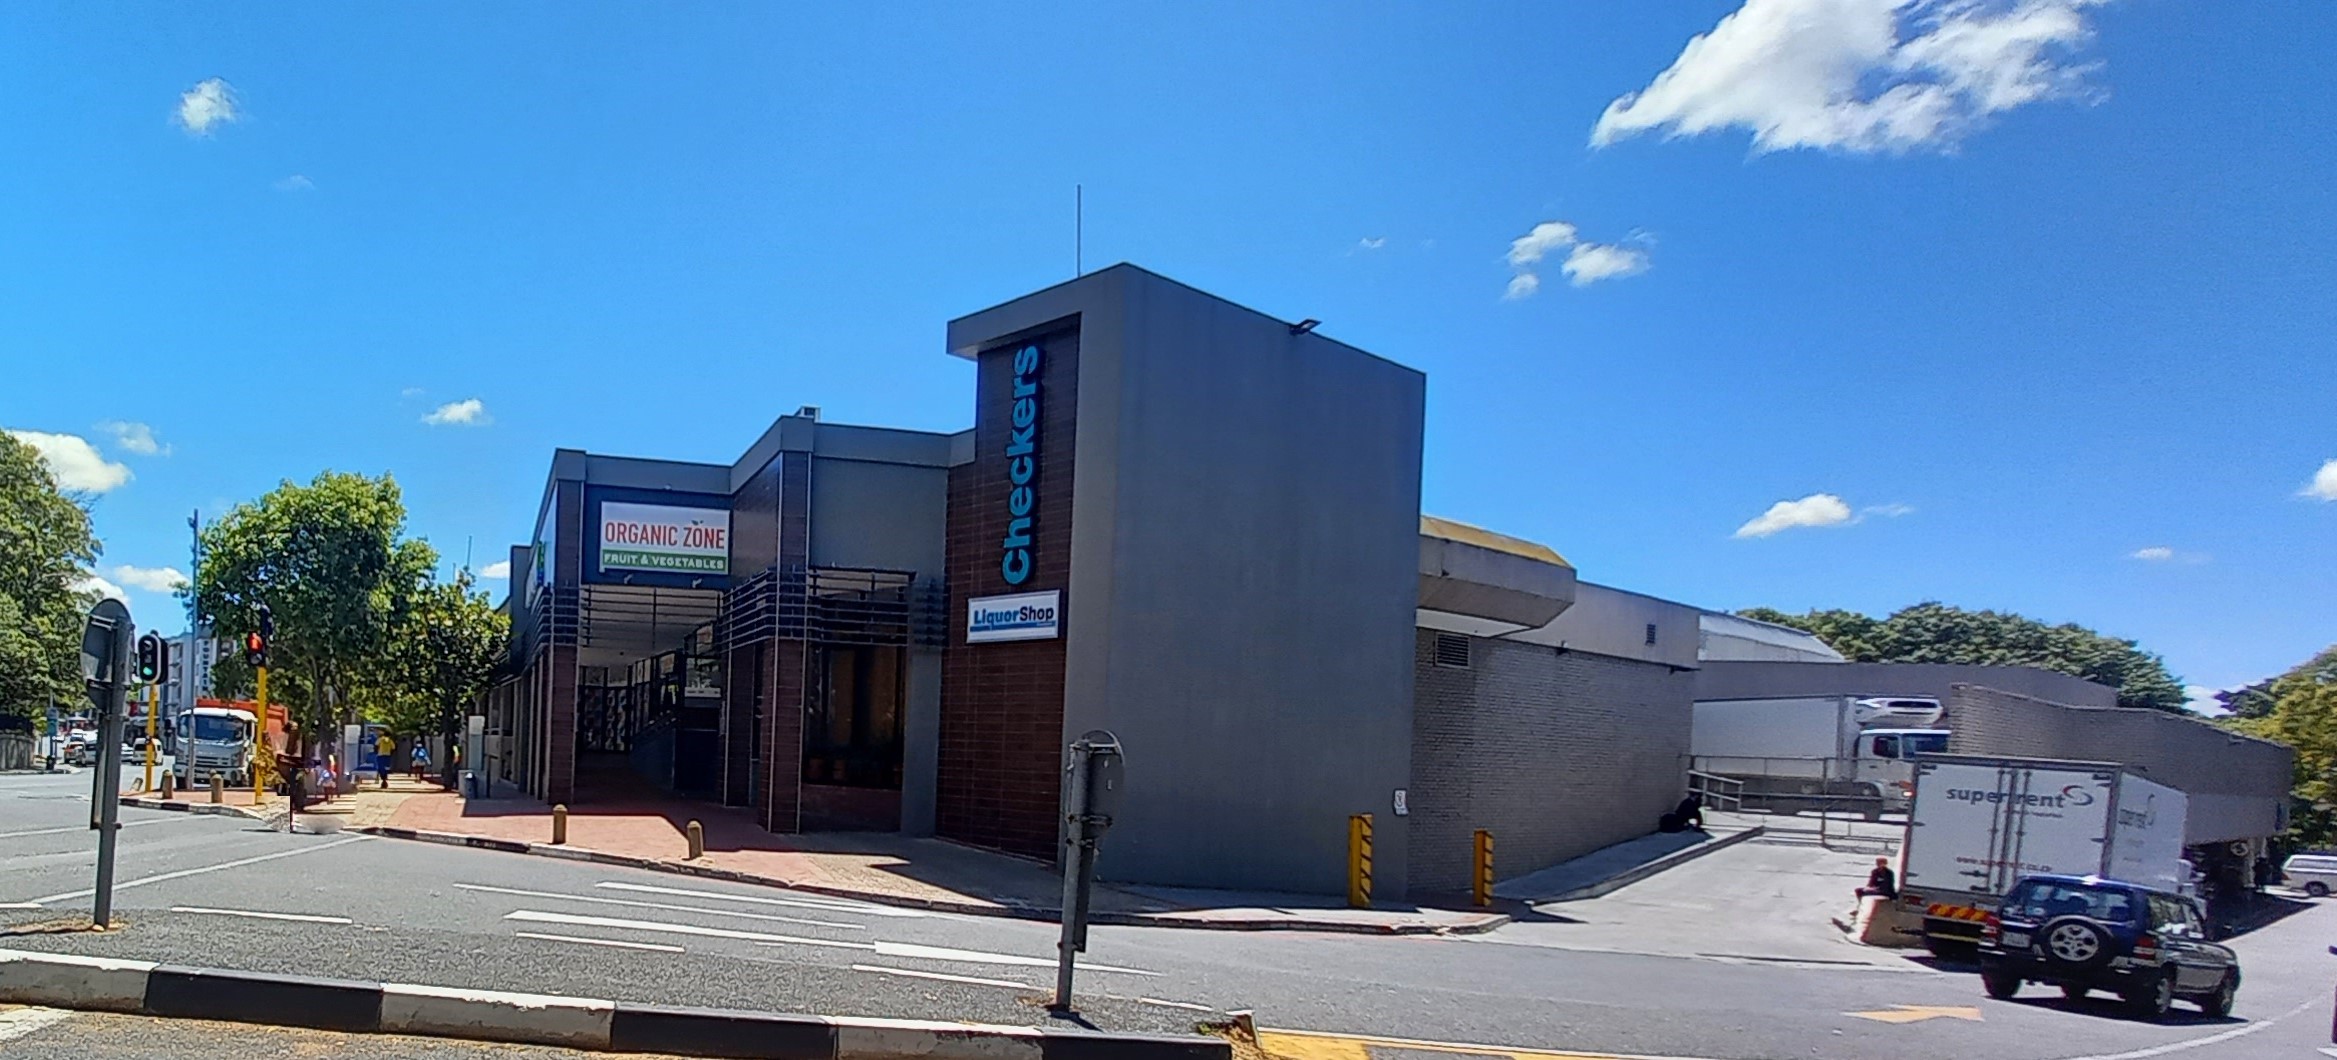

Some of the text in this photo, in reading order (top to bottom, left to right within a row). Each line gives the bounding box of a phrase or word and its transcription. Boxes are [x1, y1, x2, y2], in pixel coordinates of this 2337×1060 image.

[1002, 345, 1039, 585] Checkers
[605, 522, 726, 549] ORGANIC ZONE
[604, 552, 724, 570] FRUIT & VEGETABLES
[973, 605, 1055, 628] LiquorShop
